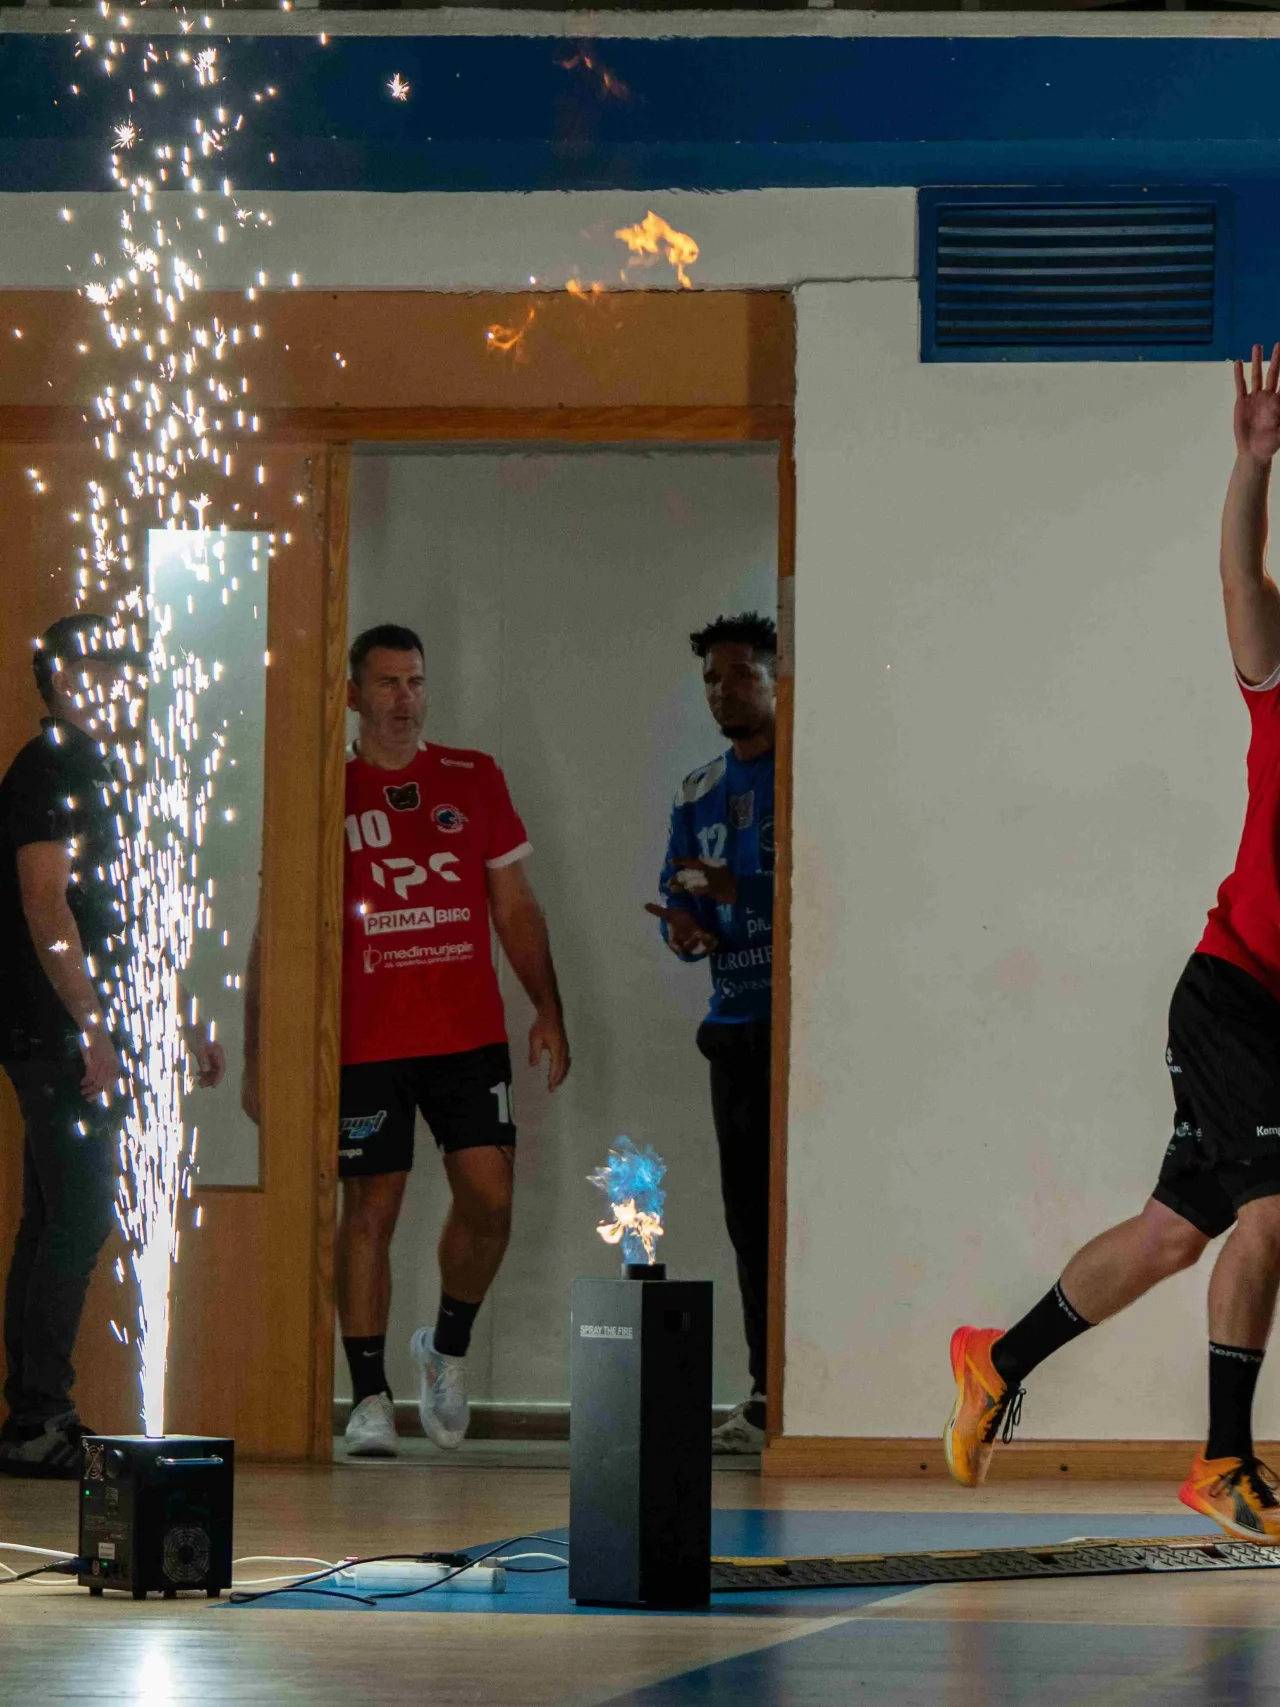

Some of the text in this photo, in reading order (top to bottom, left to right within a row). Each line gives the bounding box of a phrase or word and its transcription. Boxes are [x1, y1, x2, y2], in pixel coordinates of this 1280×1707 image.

[345, 809, 392, 851] 10
[697, 822, 727, 866] 12
[339, 1148, 363, 1159] mpa
[580, 1325, 633, 1335] SPRAY THE FIRE
